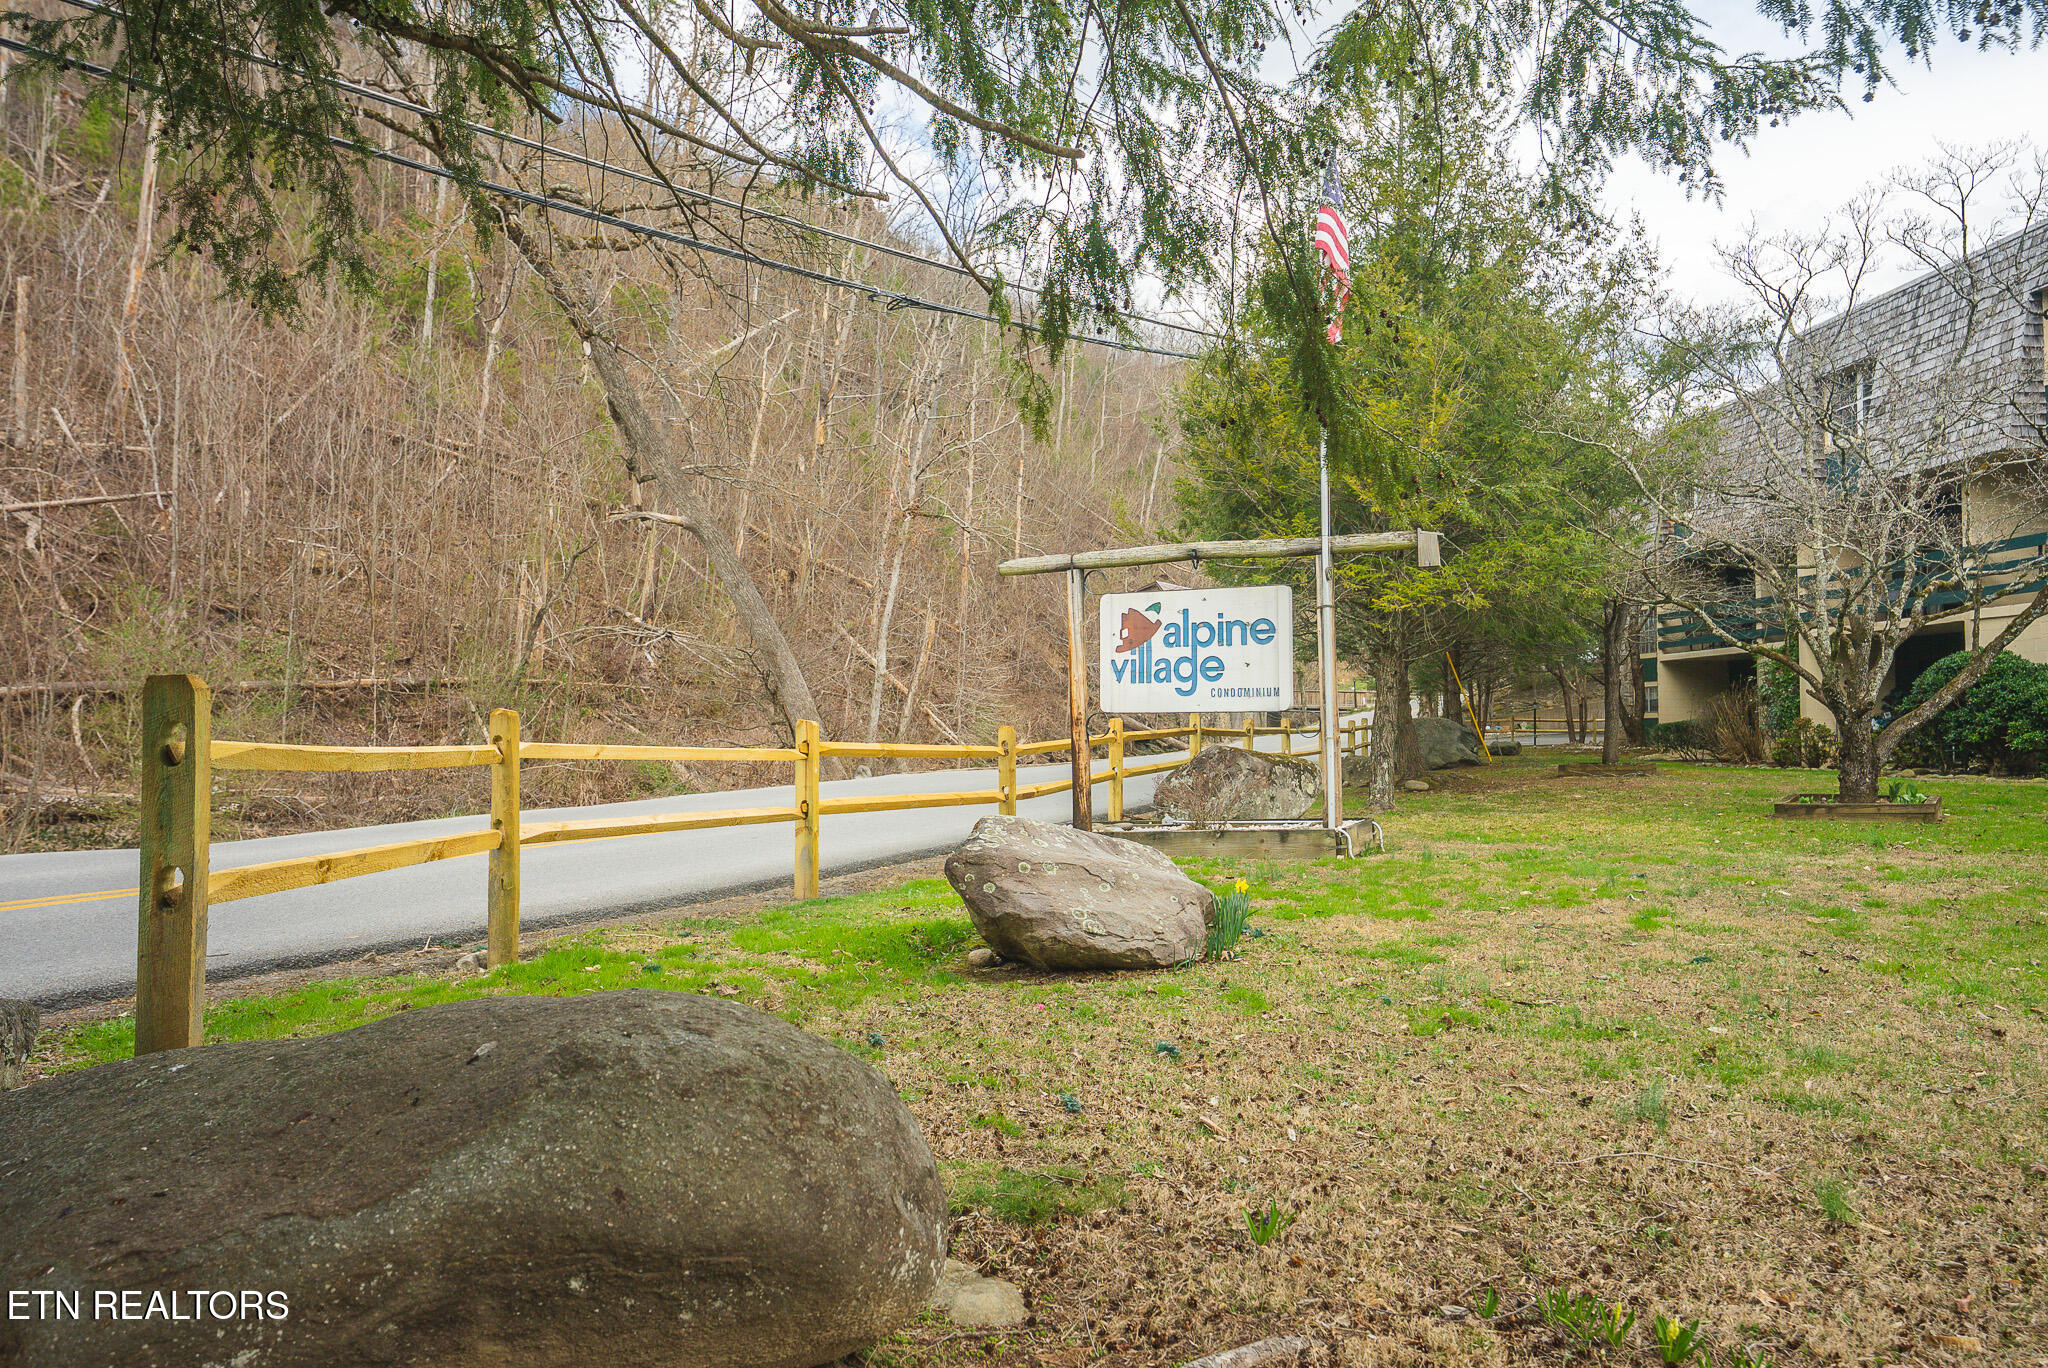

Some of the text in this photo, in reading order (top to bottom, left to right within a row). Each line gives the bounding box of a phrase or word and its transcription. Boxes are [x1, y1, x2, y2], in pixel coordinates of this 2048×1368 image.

[1163, 608, 1276, 655] alpine
[1110, 639, 1225, 697] village
[1210, 687, 1280, 697] CONDOMINIUM
